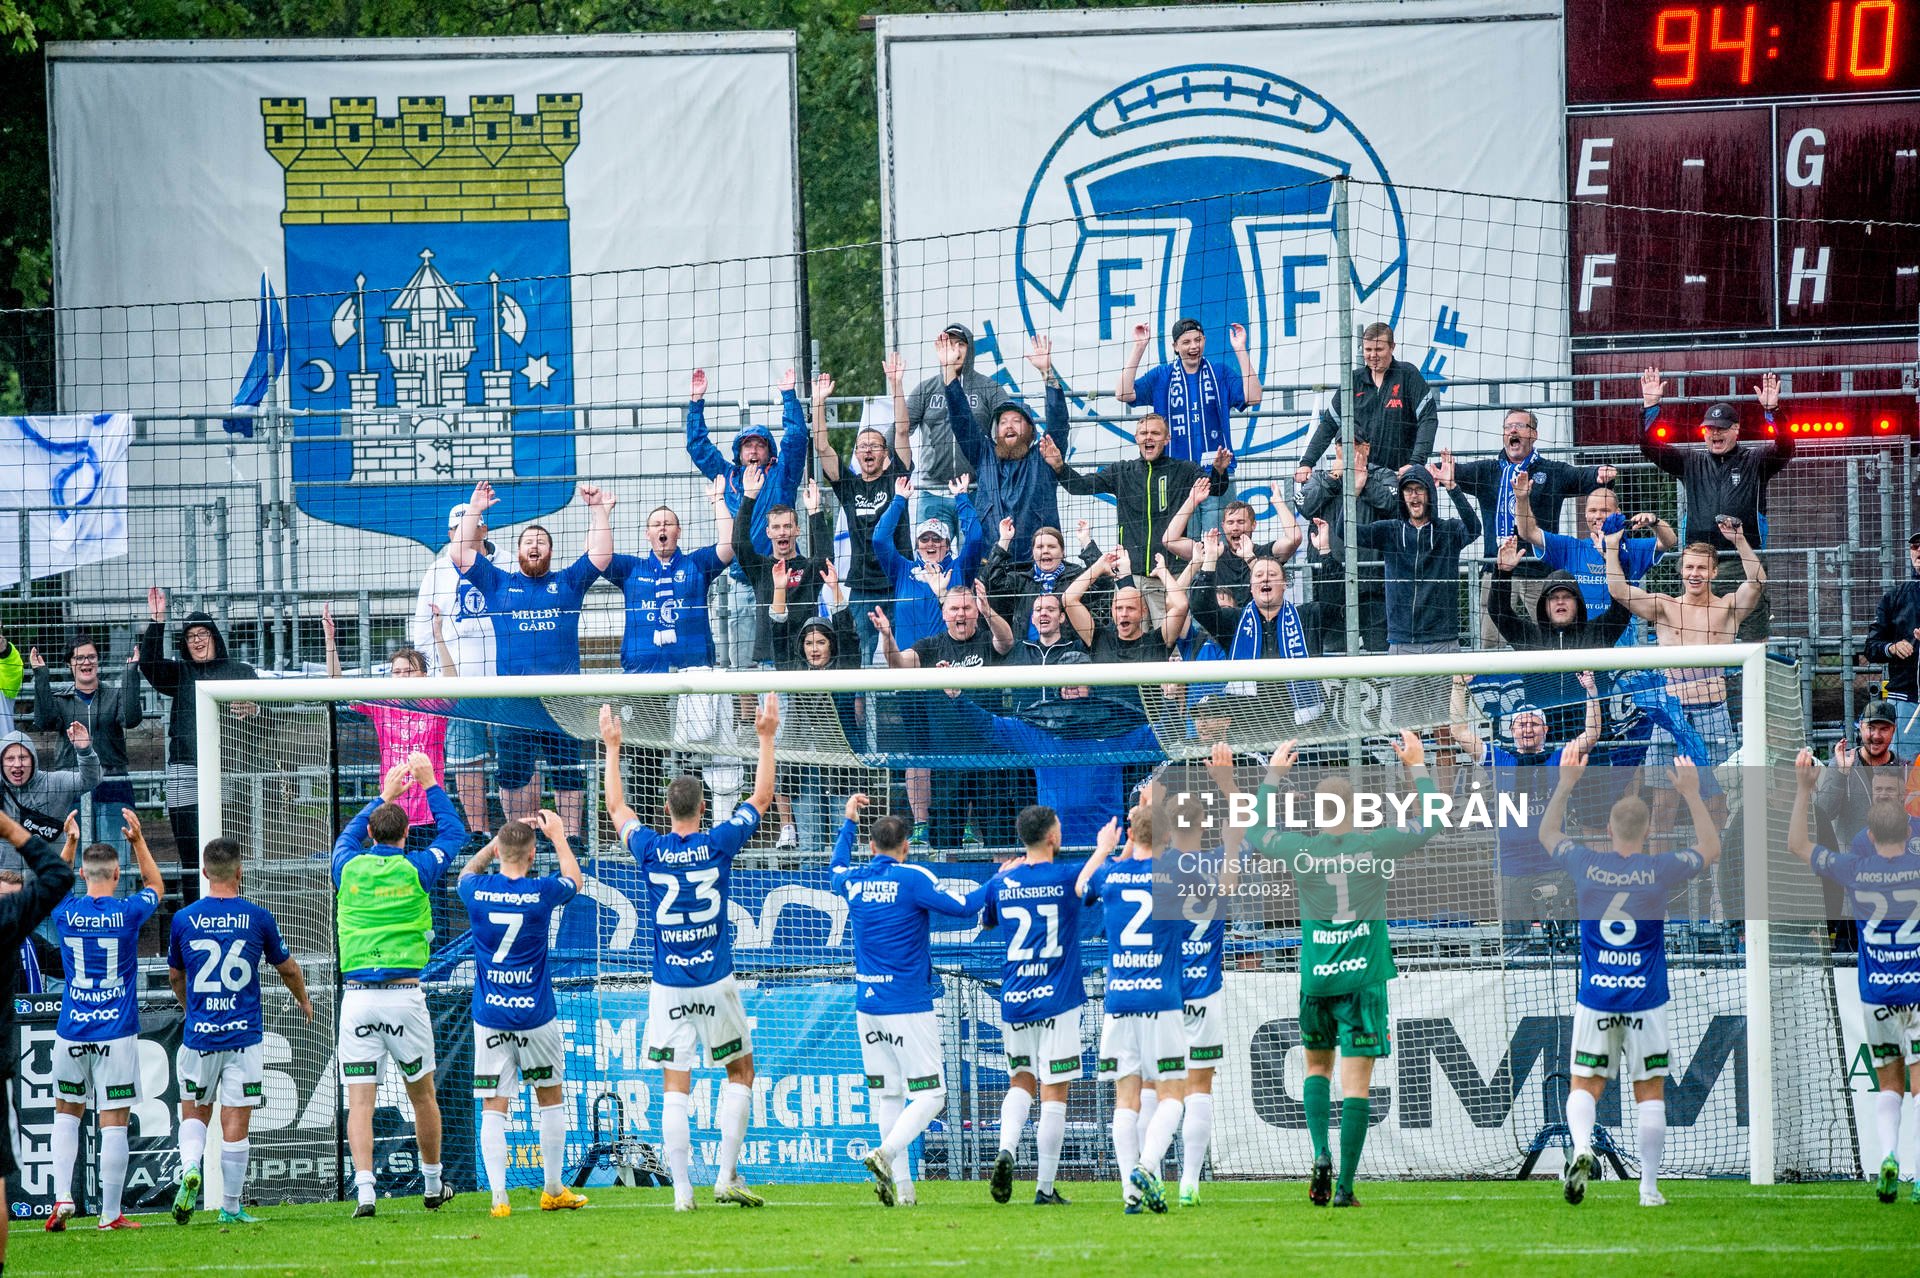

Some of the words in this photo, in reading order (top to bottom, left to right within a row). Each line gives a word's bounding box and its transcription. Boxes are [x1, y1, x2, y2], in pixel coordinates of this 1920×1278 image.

[1575, 137, 1614, 196] E
[1785, 128, 1826, 187] G
[1578, 254, 1617, 312] F
[1787, 247, 1830, 305] H
[512, 608, 560, 620] MELLBY
[519, 620, 556, 631] GÅRD
[656, 845, 710, 864] Verahill
[1132, 873, 1173, 884] KAPITAL
[1586, 865, 1655, 886] KappAhl
[1856, 871, 1882, 883] AROS
[1884, 869, 1920, 883] KAPITA
[862, 881, 899, 892] INTER
[998, 886, 1064, 901] ERIKSBERG
[474, 890, 540, 906] smarteyes
[649, 867, 721, 925] 23
[862, 891, 898, 903] SPORT
[1325, 873, 1357, 924] 1
[66, 910, 124, 928] Verahill
[189, 913, 250, 930] Verahill
[1120, 889, 1153, 946] 2
[1599, 892, 1637, 946] 6
[1855, 889, 1920, 944] 22
[489, 912, 524, 963] 7
[1001, 904, 1063, 961] 21
[64, 937, 124, 989] 11
[189, 939, 251, 992] 26
[1112, 951, 1163, 969] BJÖRKÉN
[1598, 950, 1642, 966] MODIG
[1017, 963, 1048, 977] AMIN
[206, 994, 237, 1011] BRKIĆ
[669, 1003, 715, 1020] CMM
[355, 1022, 404, 1038] CMM
[1597, 1016, 1643, 1031] CMM
[68, 1043, 110, 1058] CMM
[109, 1088, 132, 1098] akea
[779, 1131, 833, 1165] MÅL!
